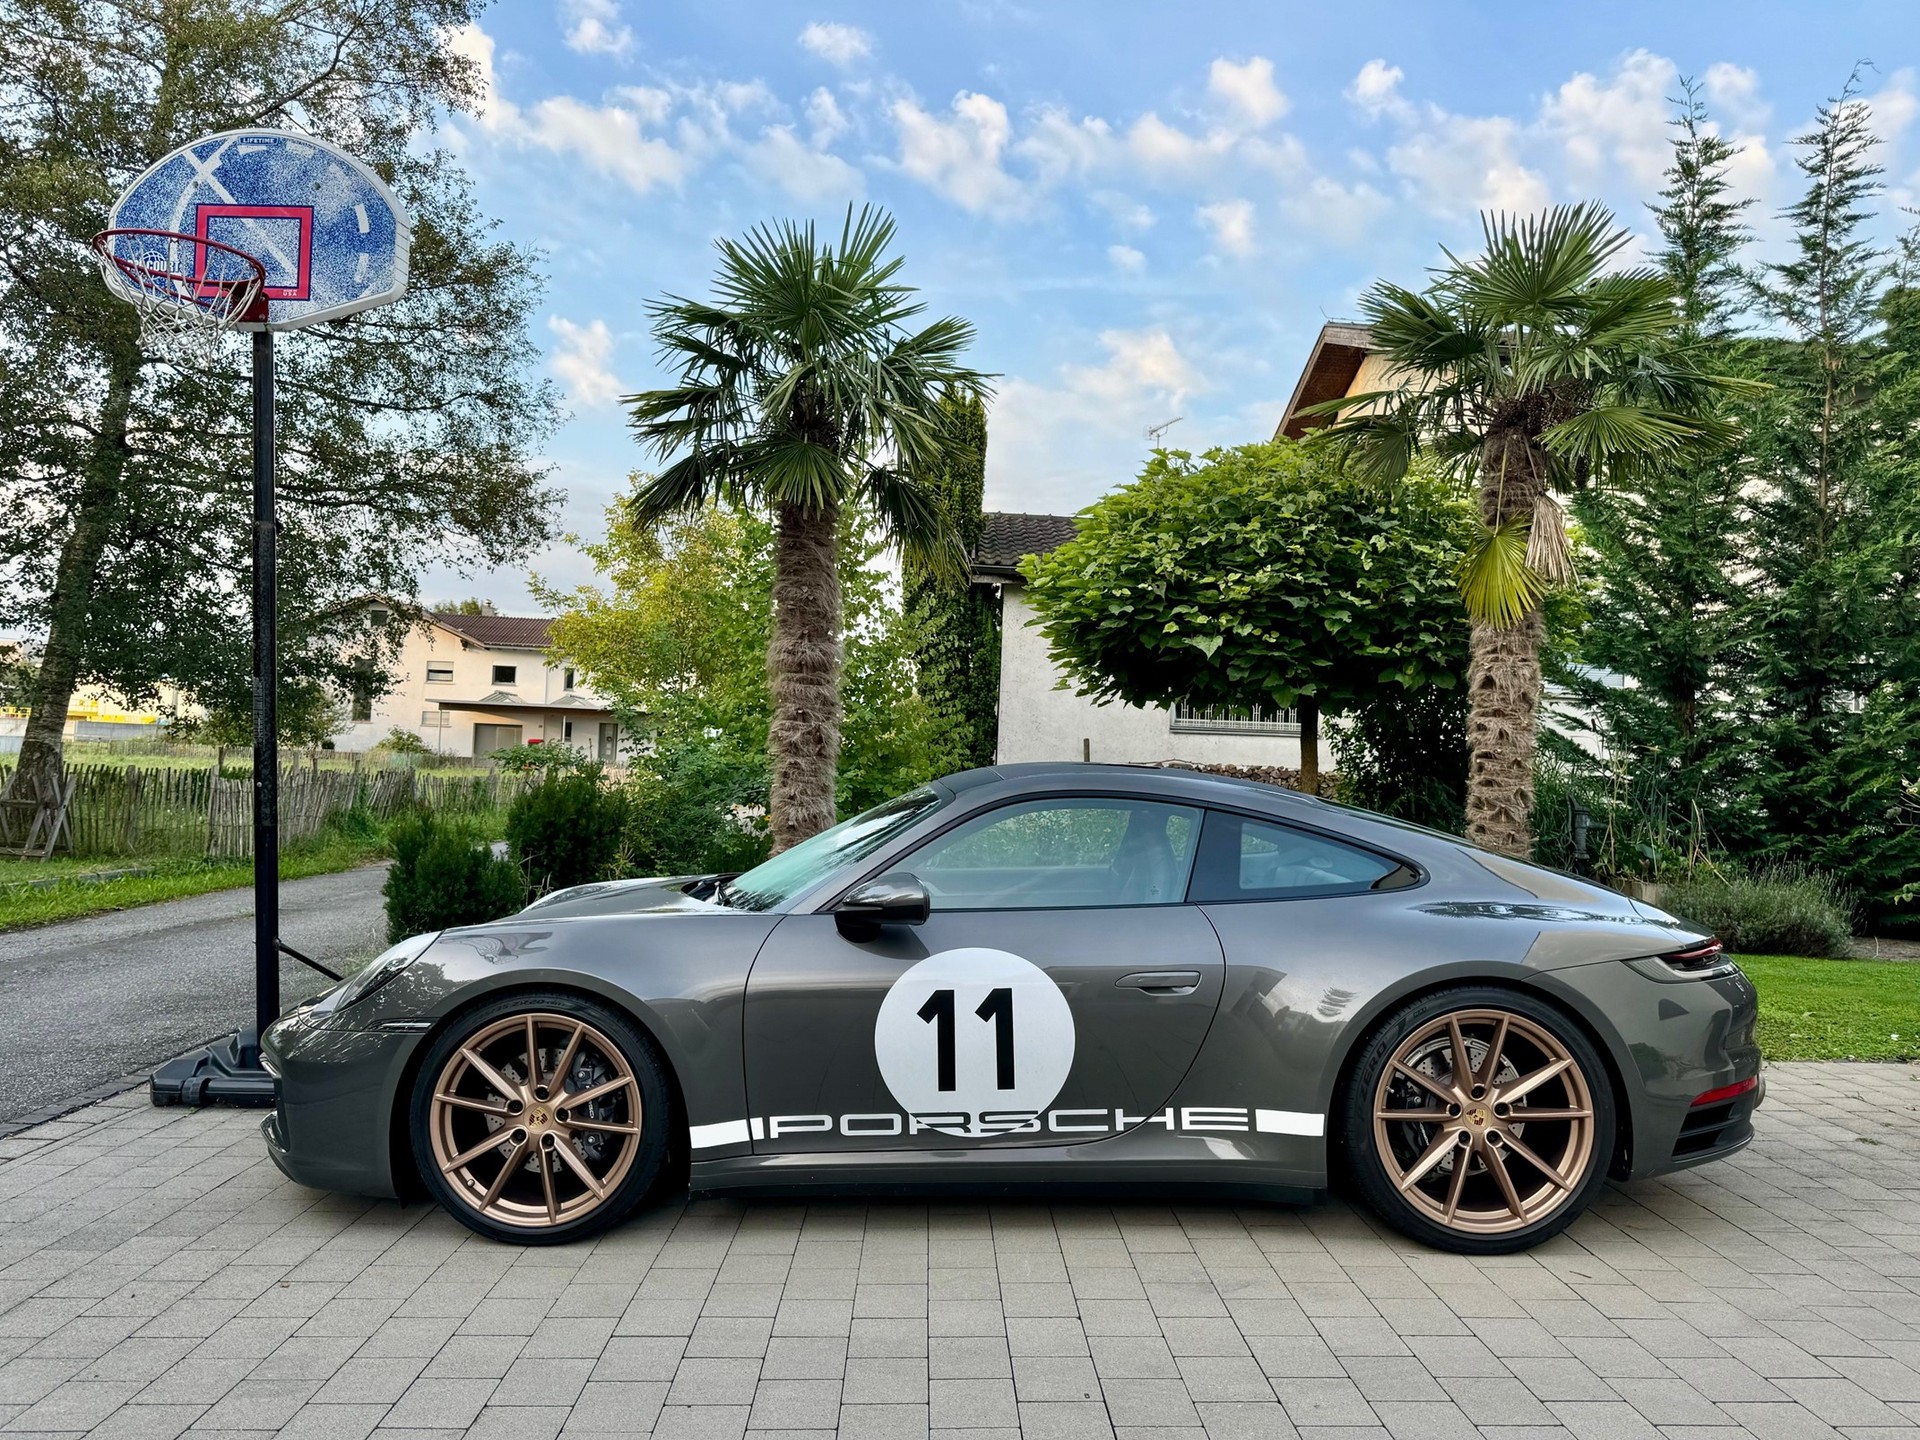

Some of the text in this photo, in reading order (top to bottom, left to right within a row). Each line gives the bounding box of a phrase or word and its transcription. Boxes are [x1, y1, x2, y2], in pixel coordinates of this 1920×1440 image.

[916, 988, 1015, 1091] 11
[1360, 1040, 1388, 1103] ZERO
[769, 1107, 1249, 1139] PORSCHE
